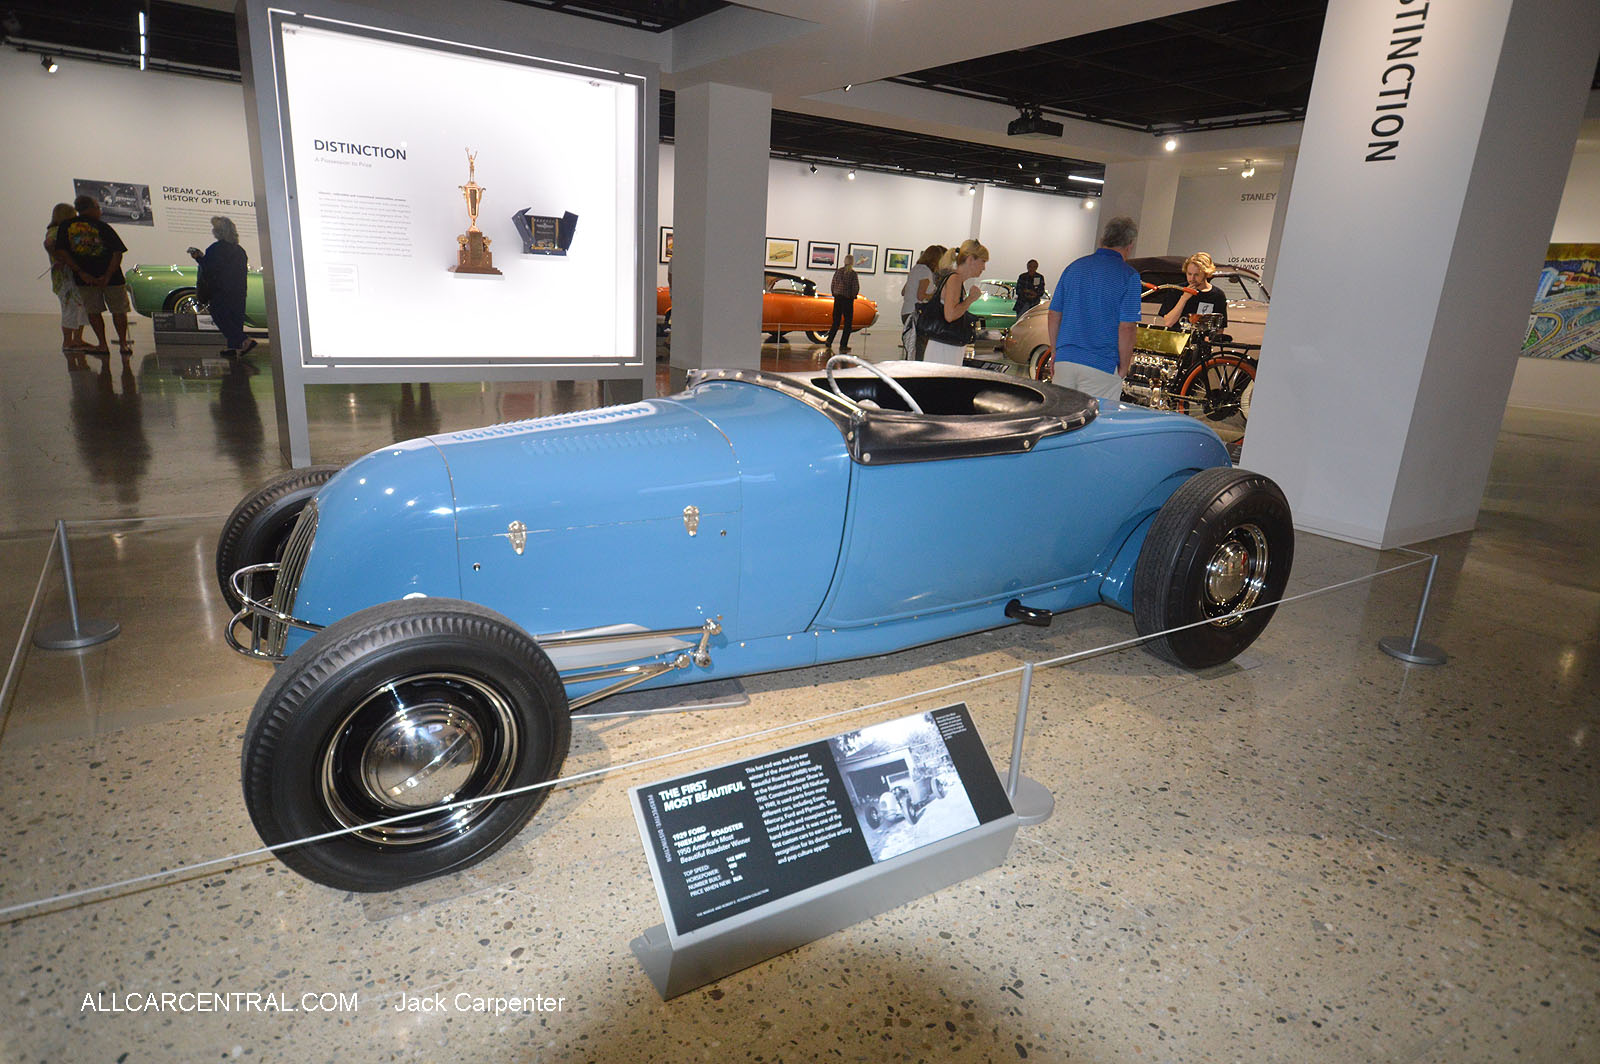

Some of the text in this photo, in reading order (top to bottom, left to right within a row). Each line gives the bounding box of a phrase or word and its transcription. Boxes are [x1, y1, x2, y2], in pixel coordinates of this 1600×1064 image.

[1365, 0, 1429, 162] TINCTION
[314, 140, 406, 160] DISTINCTION
[163, 186, 194, 194] DREAM
[164, 194, 198, 202] HISTORY
[1241, 192, 1276, 201] STANLEY
[658, 779, 707, 801] THE FIRST
[664, 781, 746, 812] MOST BEAUTIFUL
[672, 825, 706, 841] 1929 FORD
[711, 822, 744, 837] ROADSTER
[658, 828, 672, 862] DISTINCTION
[677, 846, 691, 856] 1950
[719, 834, 734, 843] Most
[680, 837, 750, 864] Beautiful Roadster Winner
